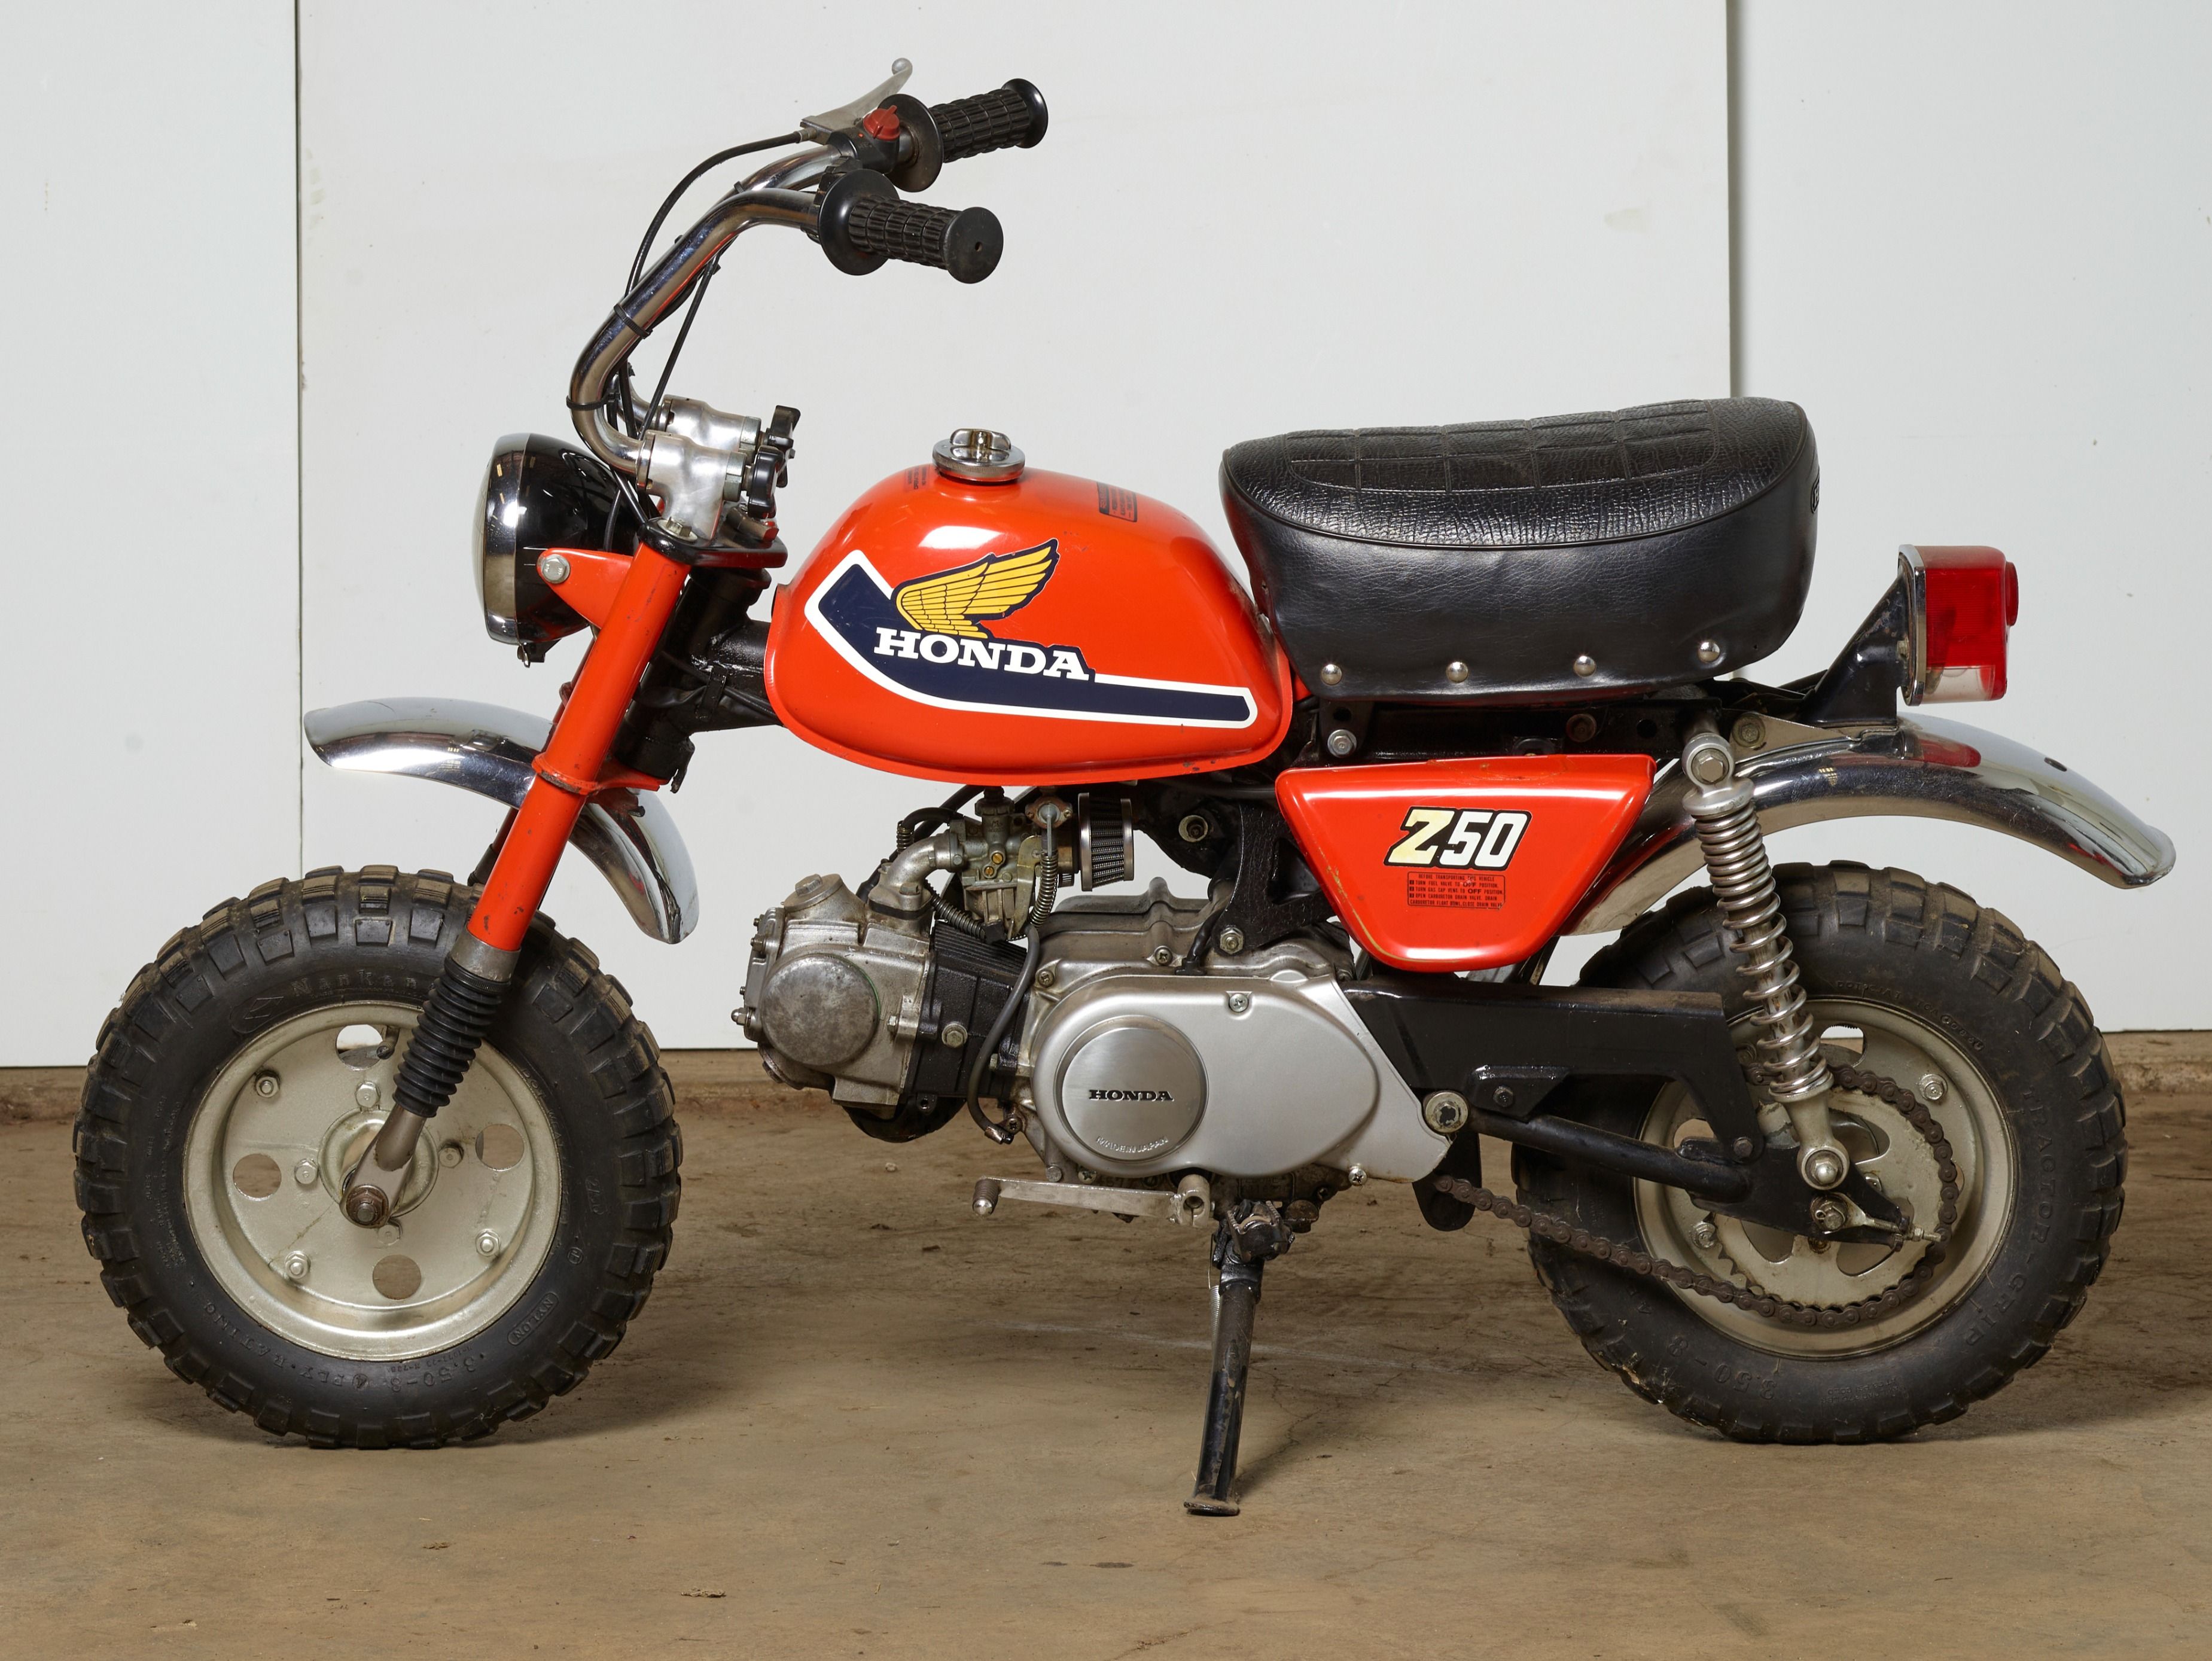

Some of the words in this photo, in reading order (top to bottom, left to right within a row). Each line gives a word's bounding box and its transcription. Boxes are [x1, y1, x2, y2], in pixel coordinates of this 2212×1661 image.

[874, 627, 1096, 681] HONDA
[1387, 809, 1529, 867] Z50
[1089, 1089, 1174, 1101] HONDA
[1096, 1136, 1126, 1152] MADE
[1138, 1136, 1169, 1153] JAPAN
[205, 1299, 287, 1369] RATING
[512, 1297, 554, 1340] NYLON
[298, 1363, 345, 1387] PLY
[1667, 1334, 1778, 1401] 3.50-8
